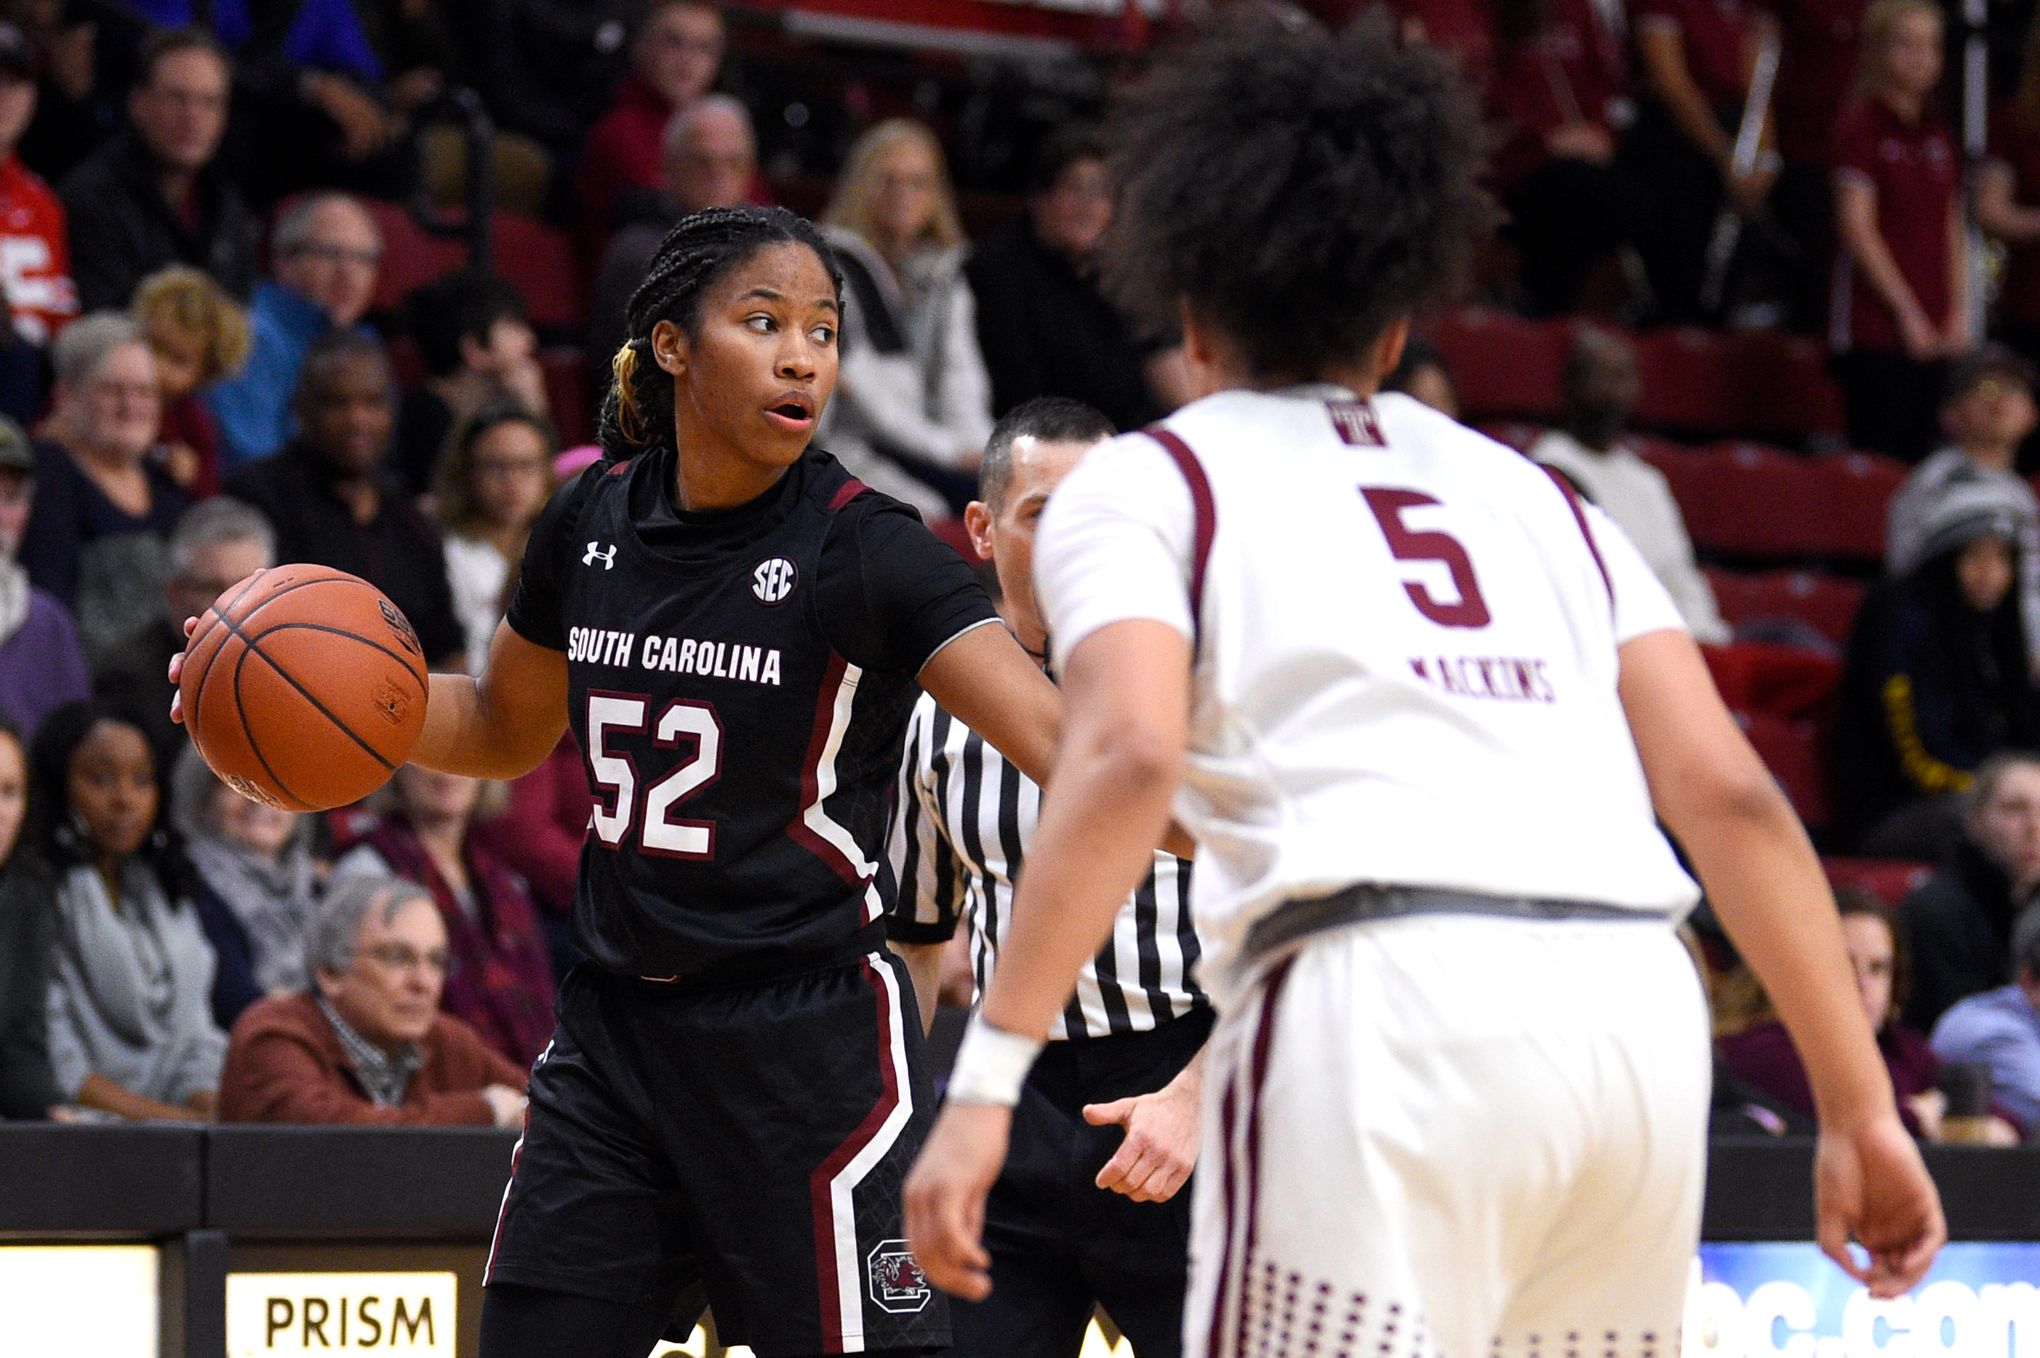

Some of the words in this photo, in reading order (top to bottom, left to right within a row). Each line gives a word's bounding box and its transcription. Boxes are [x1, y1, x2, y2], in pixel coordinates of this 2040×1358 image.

[751, 558, 795, 602] SEC
[1358, 485, 1492, 629] 5
[568, 626, 635, 668] SOUTH
[641, 635, 781, 686] CAROLINA
[587, 688, 725, 861] 52
[266, 1296, 436, 1347] PRISM
